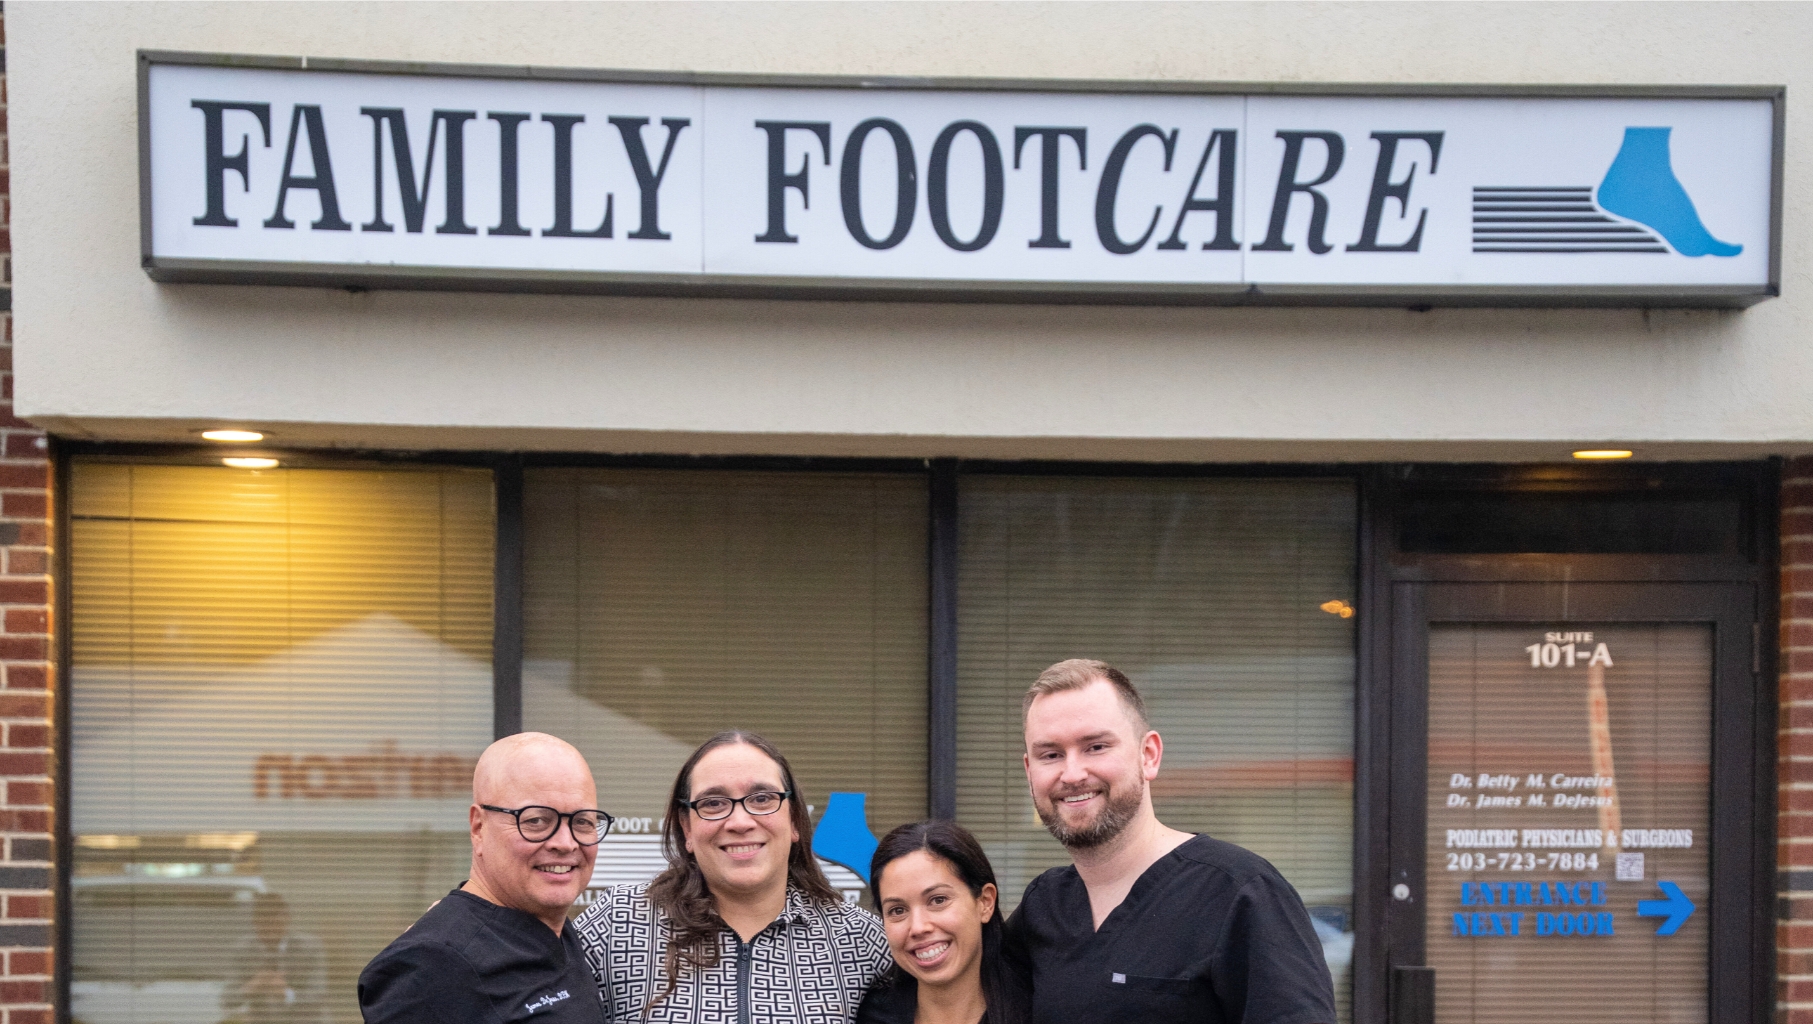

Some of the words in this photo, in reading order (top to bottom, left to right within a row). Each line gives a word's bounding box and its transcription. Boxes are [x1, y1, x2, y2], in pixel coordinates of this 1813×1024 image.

[191, 99, 691, 241] FAMILY
[755, 117, 1446, 255] FOOTCARE
[1545, 632, 1594, 644] SUITE
[1525, 643, 1614, 668] 101-A
[1450, 774, 1472, 788] Dr.
[1477, 774, 1520, 792] Betty
[1525, 774, 1547, 788] M.
[1550, 773, 1613, 788] Carreira
[1447, 794, 1471, 807] Dr.
[1476, 794, 1522, 810] James
[1527, 794, 1547, 807] M.
[1552, 794, 1614, 809] DeJesus
[1446, 829, 1518, 848] PODIATRIC
[1521, 829, 1603, 848] PHYSICIANS
[1606, 830, 1618, 848] &
[1622, 829, 1693, 848] SURGEONS
[1446, 852, 1599, 871] 203-723-7884
[1461, 882, 1607, 906] ENTRANCE
[1452, 912, 1525, 937] NEXT
[1536, 912, 1615, 937] DOOR
